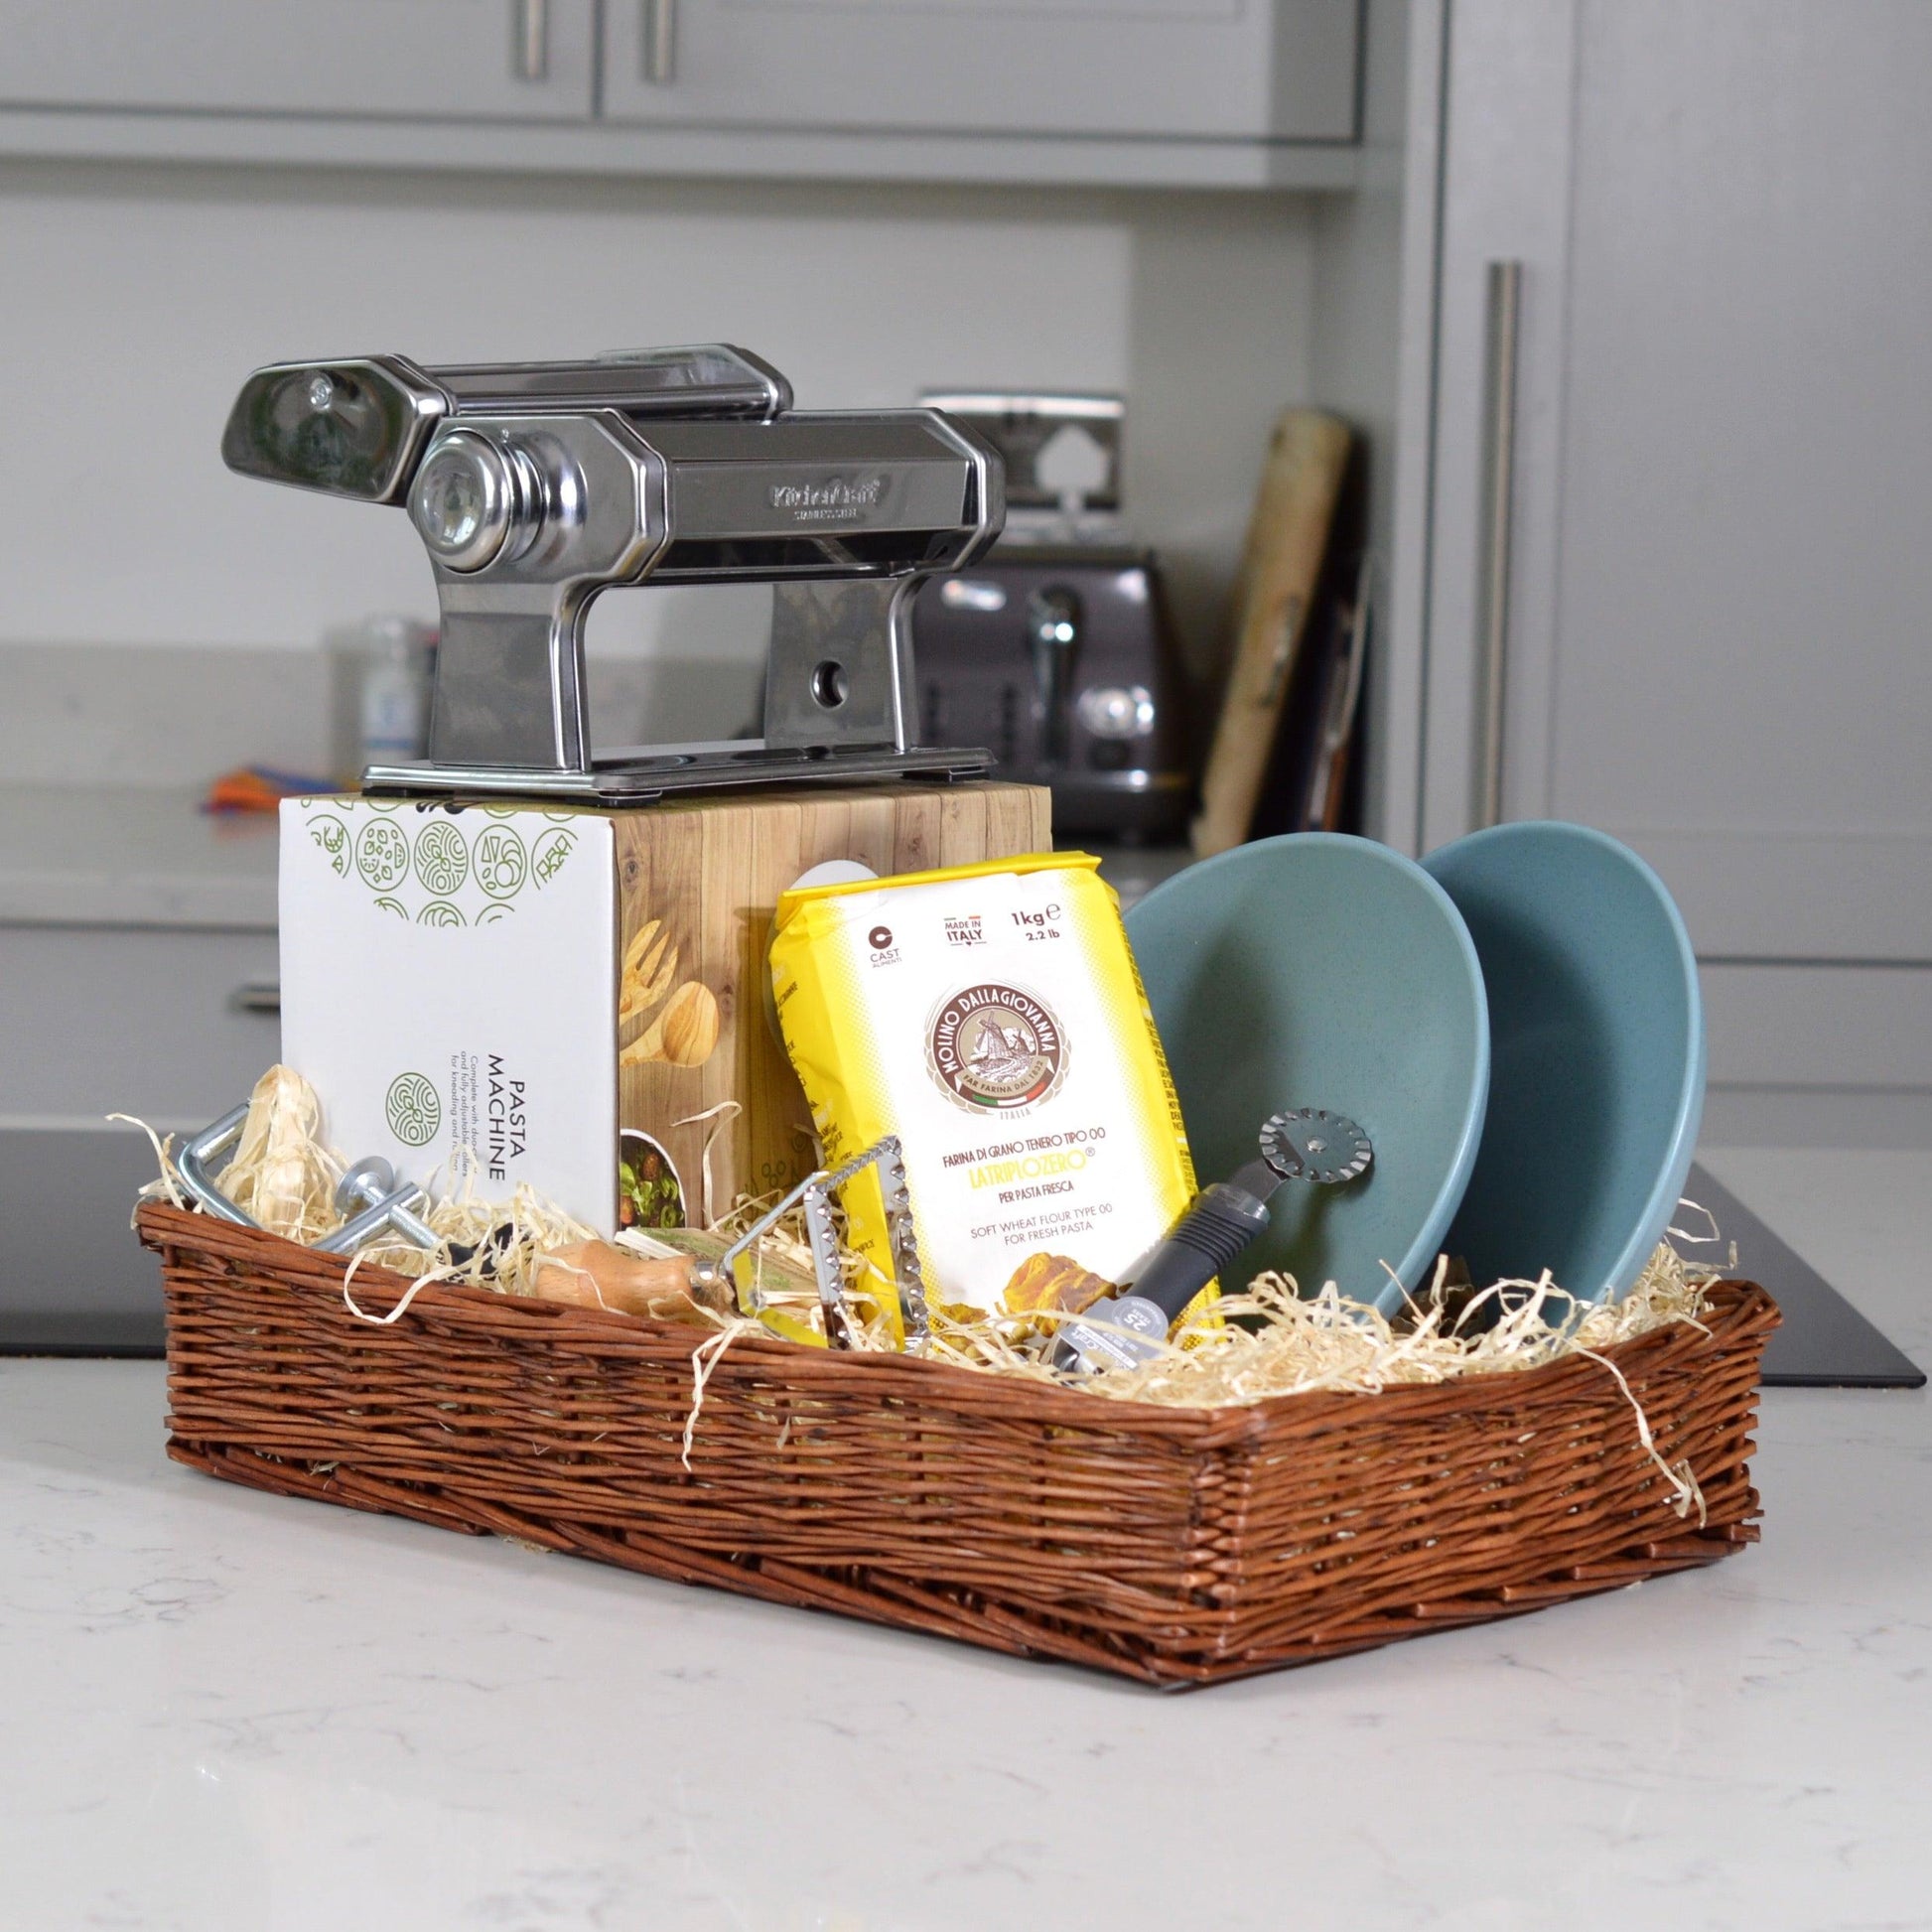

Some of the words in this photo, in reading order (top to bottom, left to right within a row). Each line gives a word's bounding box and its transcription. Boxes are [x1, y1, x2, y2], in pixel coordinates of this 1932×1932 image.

[944, 921, 970, 930] MADE
[1011, 911, 1045, 926] 1kg
[946, 929, 983, 942] ITALY
[1025, 931, 1045, 941] 2.2
[1048, 928, 1060, 939] lb
[870, 948, 899, 963] CAST
[937, 1010, 960, 1074] MOLINO
[958, 988, 1057, 1052] DALLAGIOVANNA
[450, 1070, 459, 1116] kneading
[460, 1072, 469, 1093] fully
[963, 1074, 979, 1088] FAR
[980, 1082, 1013, 1094] FARINA
[1014, 1078, 1030, 1090] DAL
[460, 1095, 469, 1145] adjustable
[488, 1054, 505, 1181] MACHINE
[509, 1080, 526, 1158] PASTA
[942, 1150, 976, 1169] FARINA
[976, 1148, 987, 1161] DI
[988, 1141, 1025, 1159] GRANO
[1025, 1134, 1063, 1152] TENERO
[1064, 1130, 1088, 1145] TIPO
[999, 1191, 1015, 1204] PER
[1015, 1185, 1042, 1201] PASTA
[1042, 1179, 1074, 1195] FRESCA
[971, 1223, 997, 1239] SOFT
[999, 1216, 1036, 1233] WHEAT
[1039, 1210, 1072, 1225] FLOUR
[1073, 1205, 1097, 1219] TYPE
[1004, 1233, 1026, 1246] FOR
[1028, 1226, 1060, 1242] FRESH
[1060, 1221, 1094, 1235] PASTA
[1123, 1312, 1148, 1331] 25
